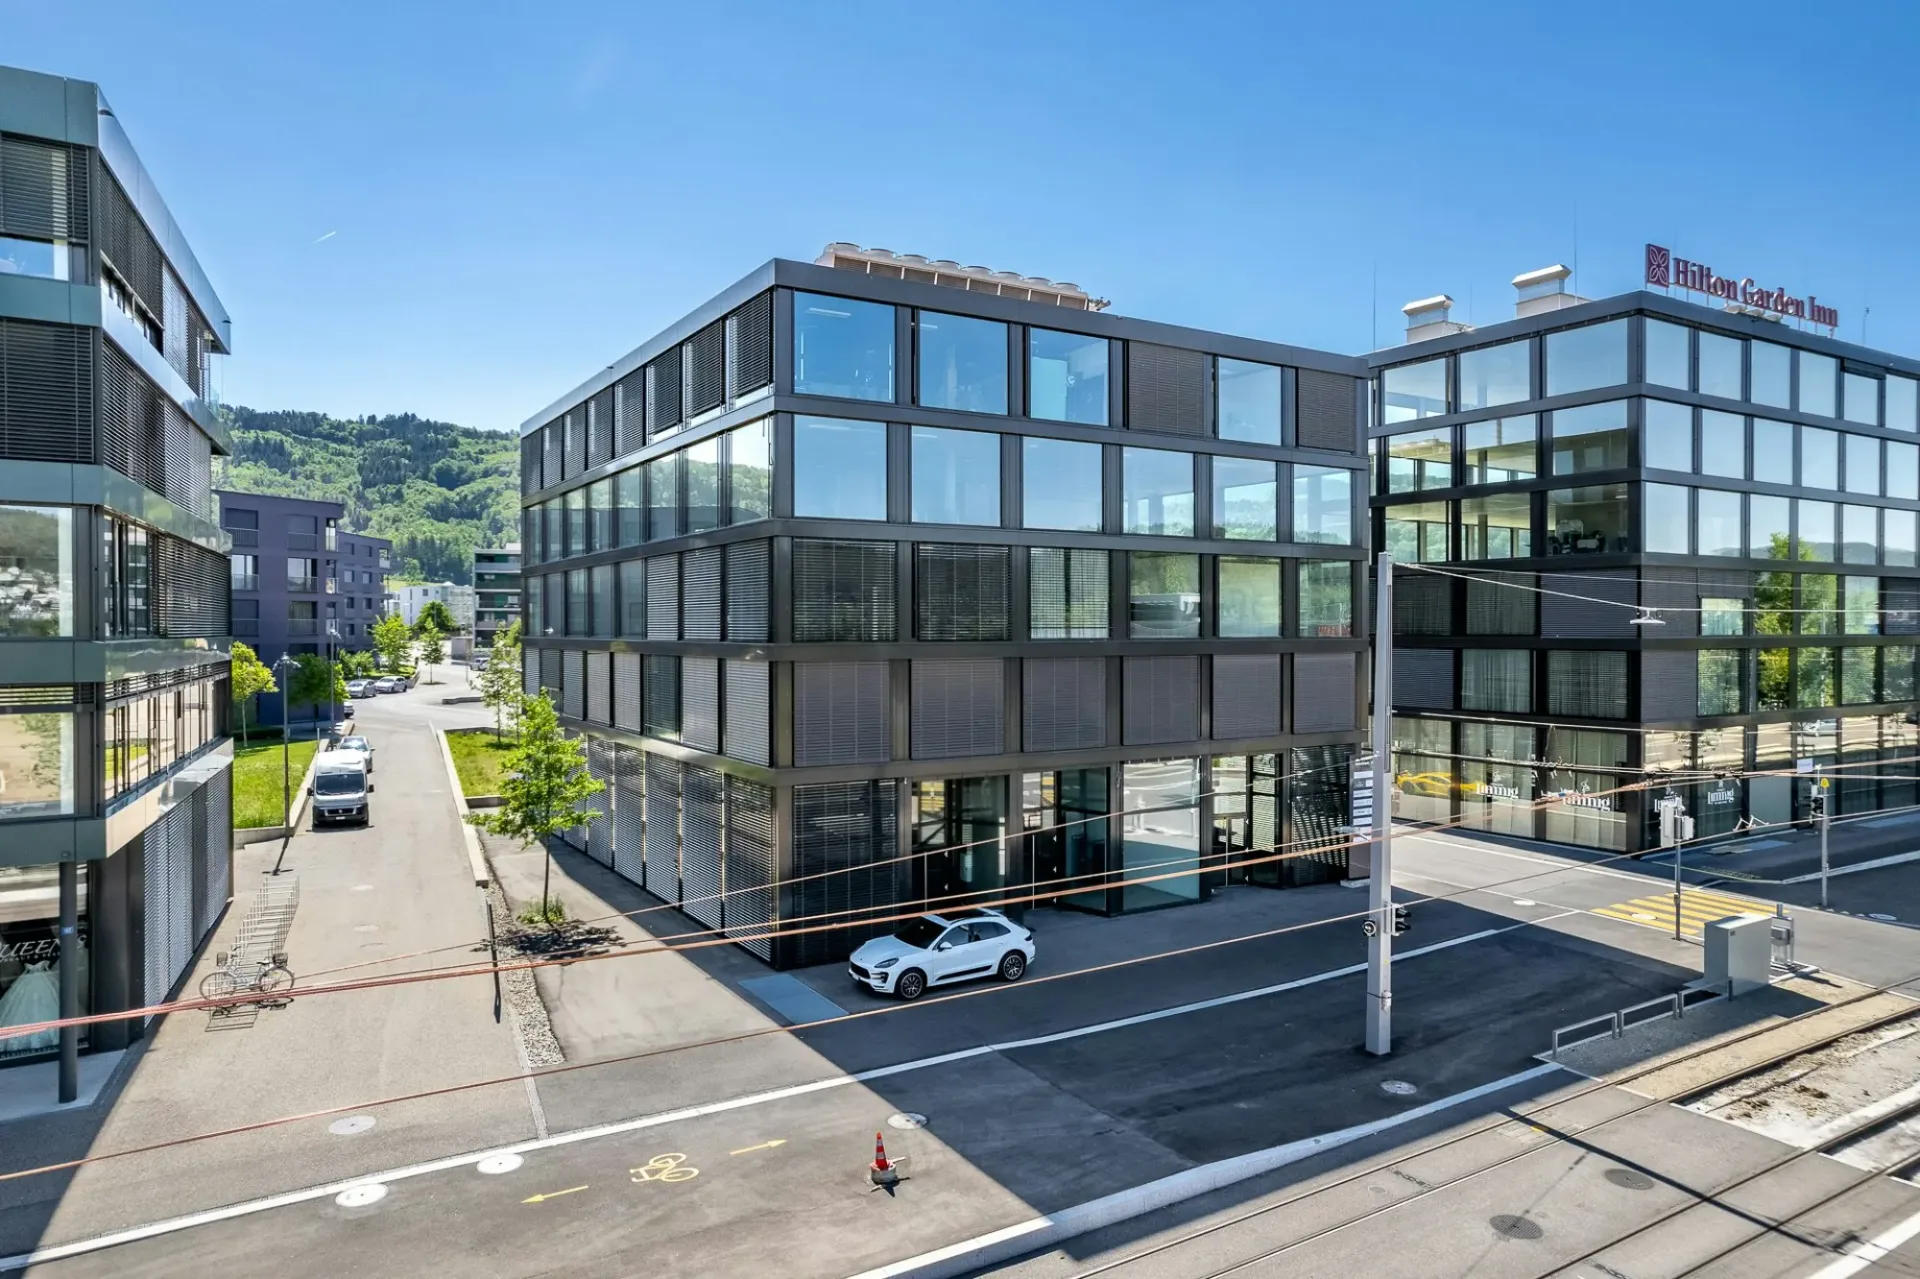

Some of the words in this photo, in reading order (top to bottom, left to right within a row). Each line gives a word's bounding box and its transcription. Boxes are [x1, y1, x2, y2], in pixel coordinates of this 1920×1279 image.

[1672, 257, 1738, 301] Hilton
[1740, 277, 1805, 319] Garden
[1807, 295, 1839, 327] Inn
